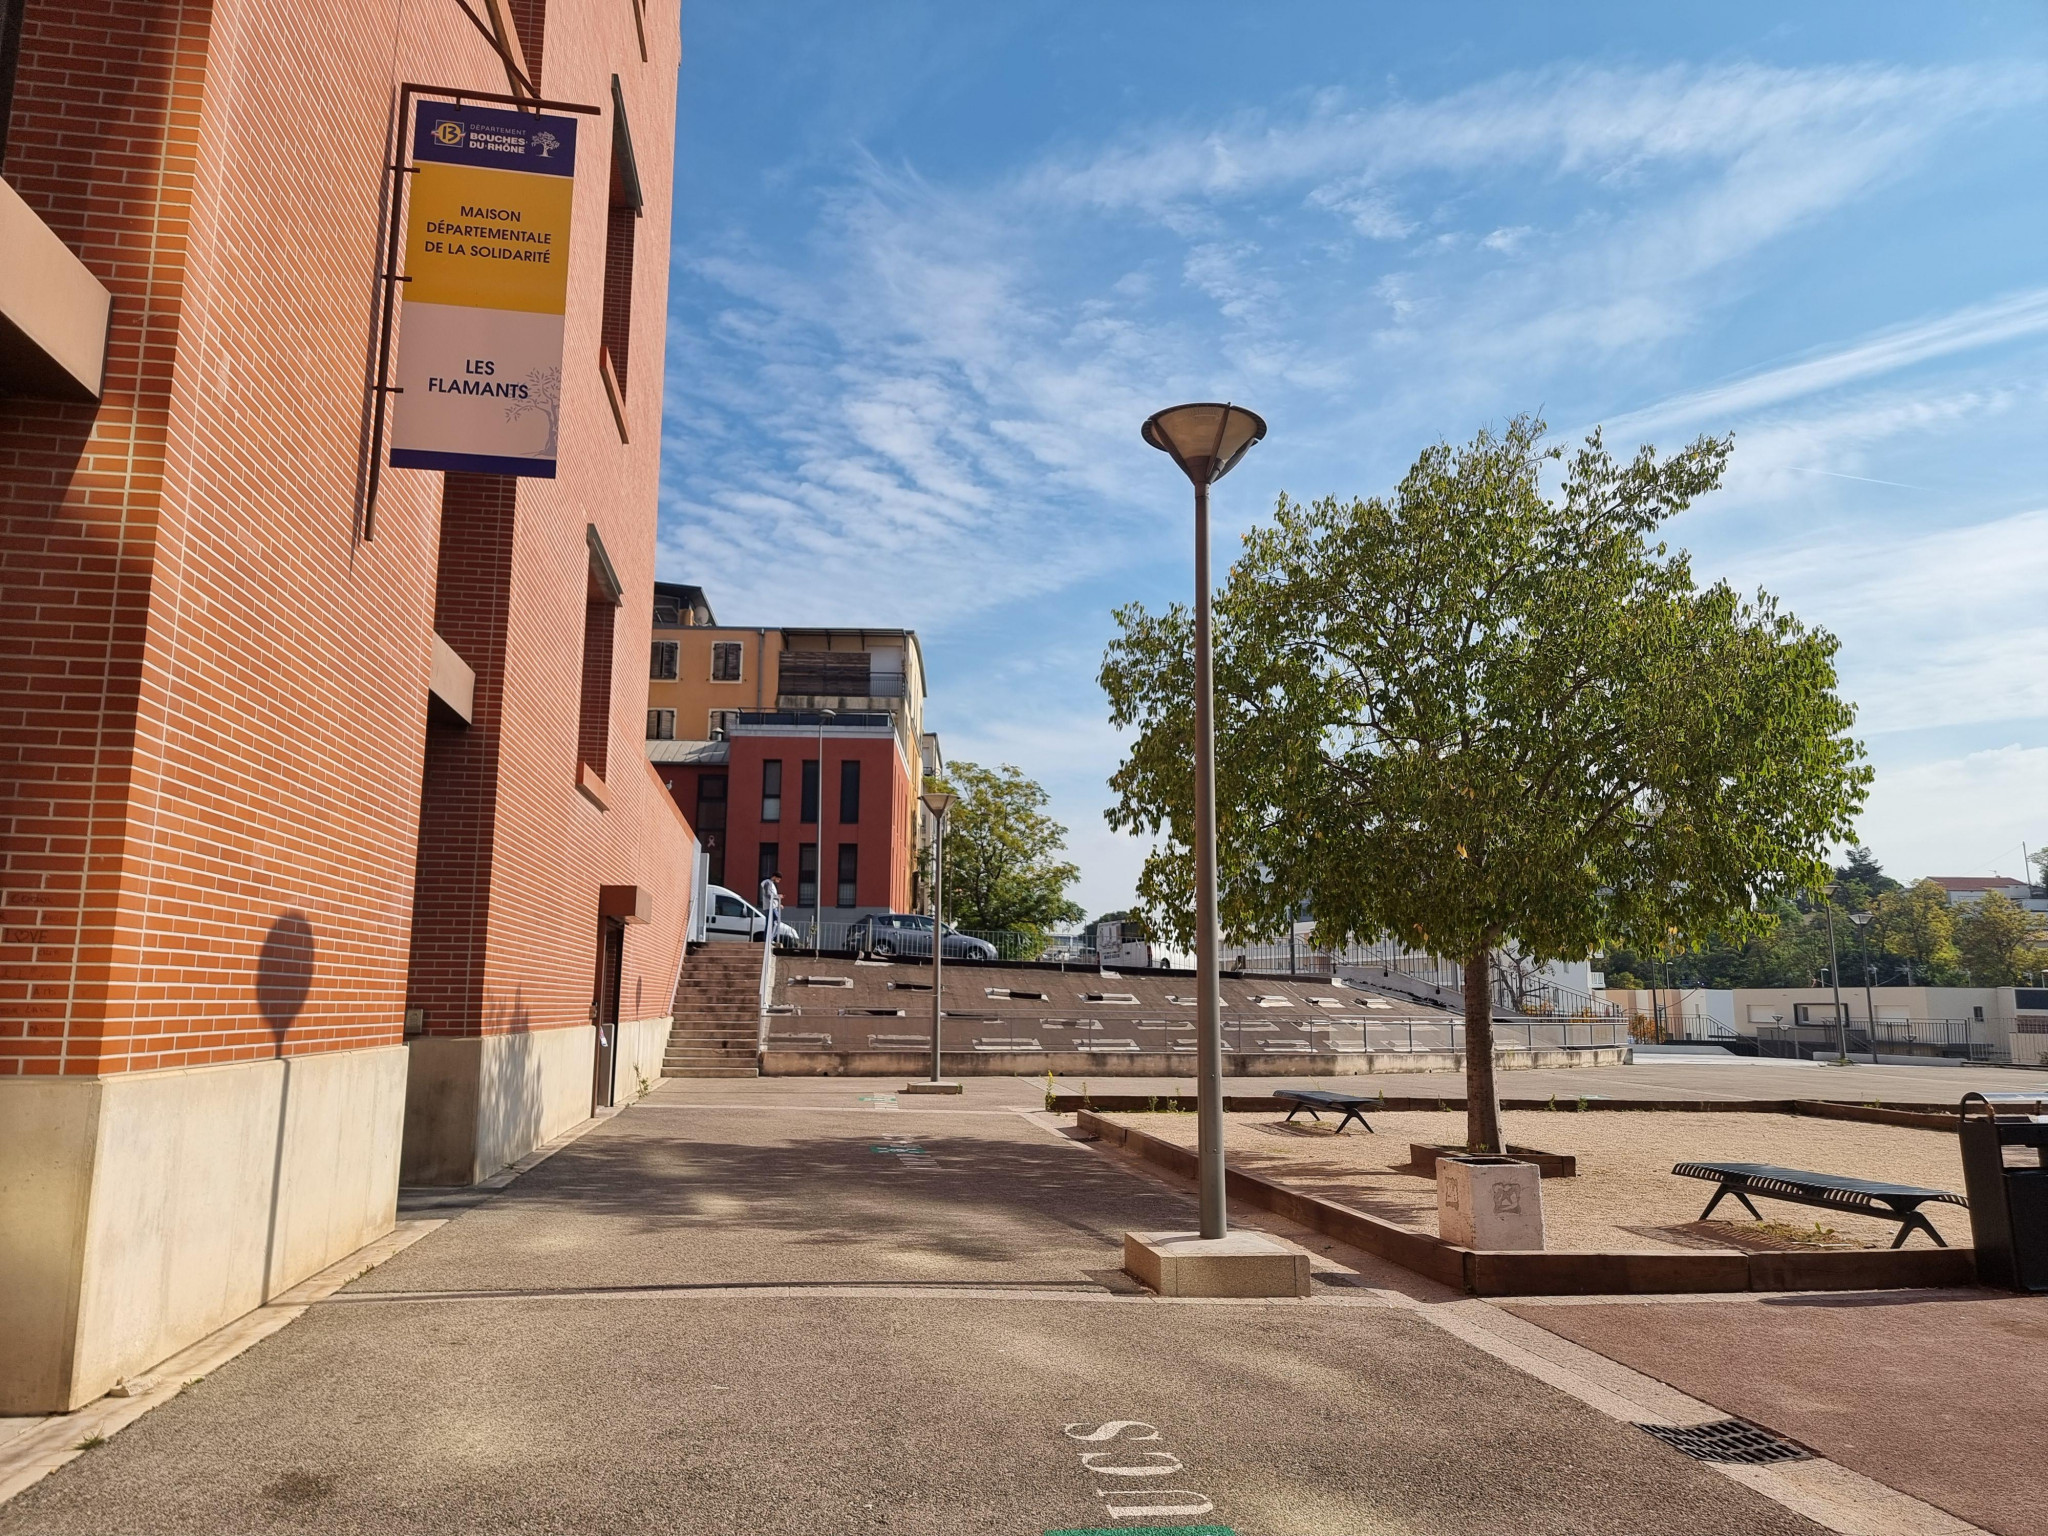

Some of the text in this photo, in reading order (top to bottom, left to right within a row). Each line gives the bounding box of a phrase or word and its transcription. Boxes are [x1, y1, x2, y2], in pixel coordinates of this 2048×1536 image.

[470, 123, 526, 136] DÉPARTEMENT
[460, 206, 521, 222] MAISON
[426, 219, 552, 244] DÉPARTEMENTALE
[425, 241, 551, 263] DE LA SOLIDARITÉ
[465, 359, 495, 376] LES
[428, 377, 529, 399] FLAMANTS
